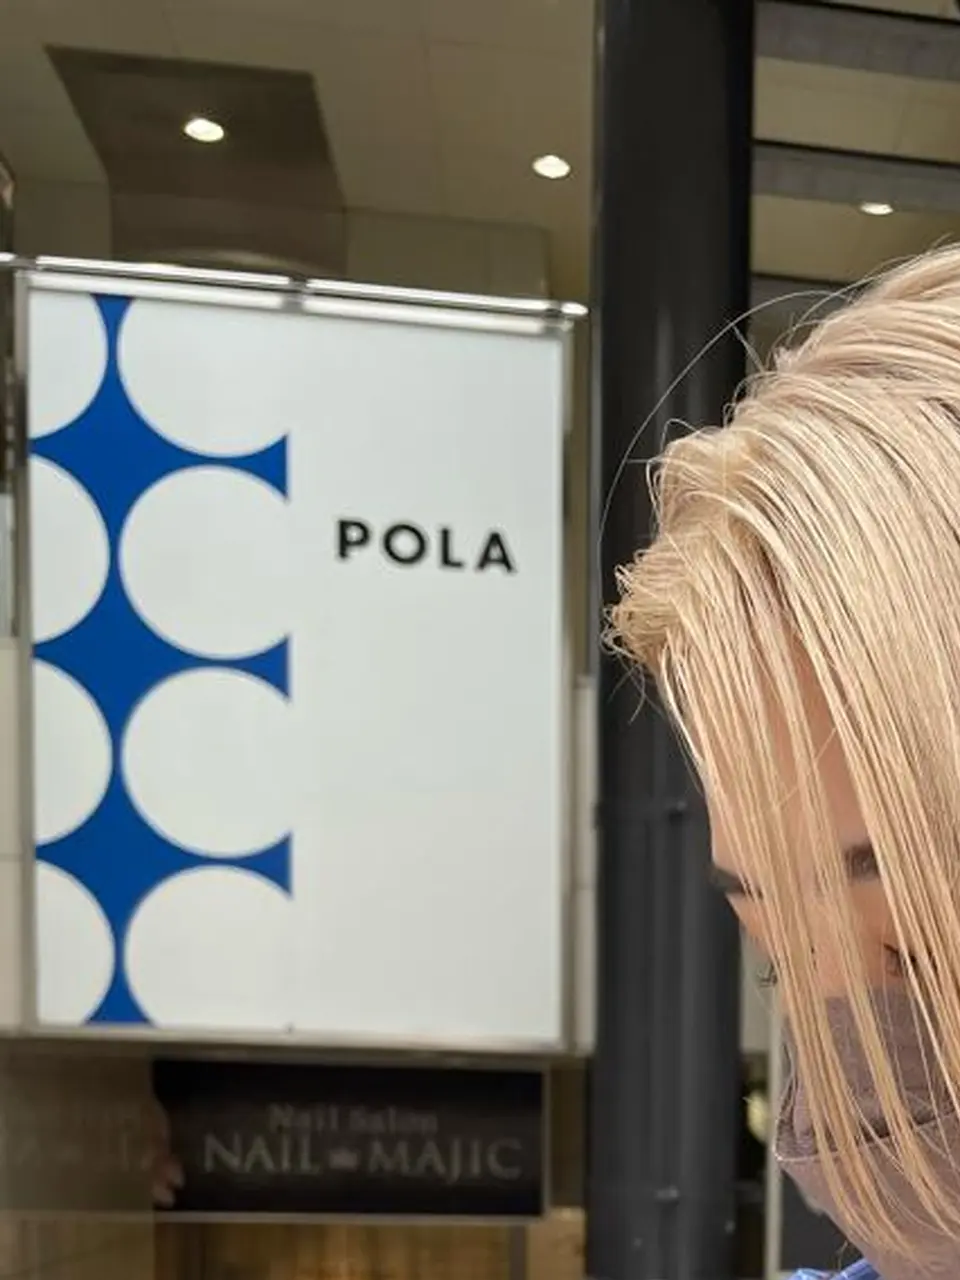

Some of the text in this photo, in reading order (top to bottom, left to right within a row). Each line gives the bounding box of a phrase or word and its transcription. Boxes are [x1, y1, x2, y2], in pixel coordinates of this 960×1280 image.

[337, 519, 515, 573] POLA
[203, 1132, 523, 1184] NAIL MAJIC
